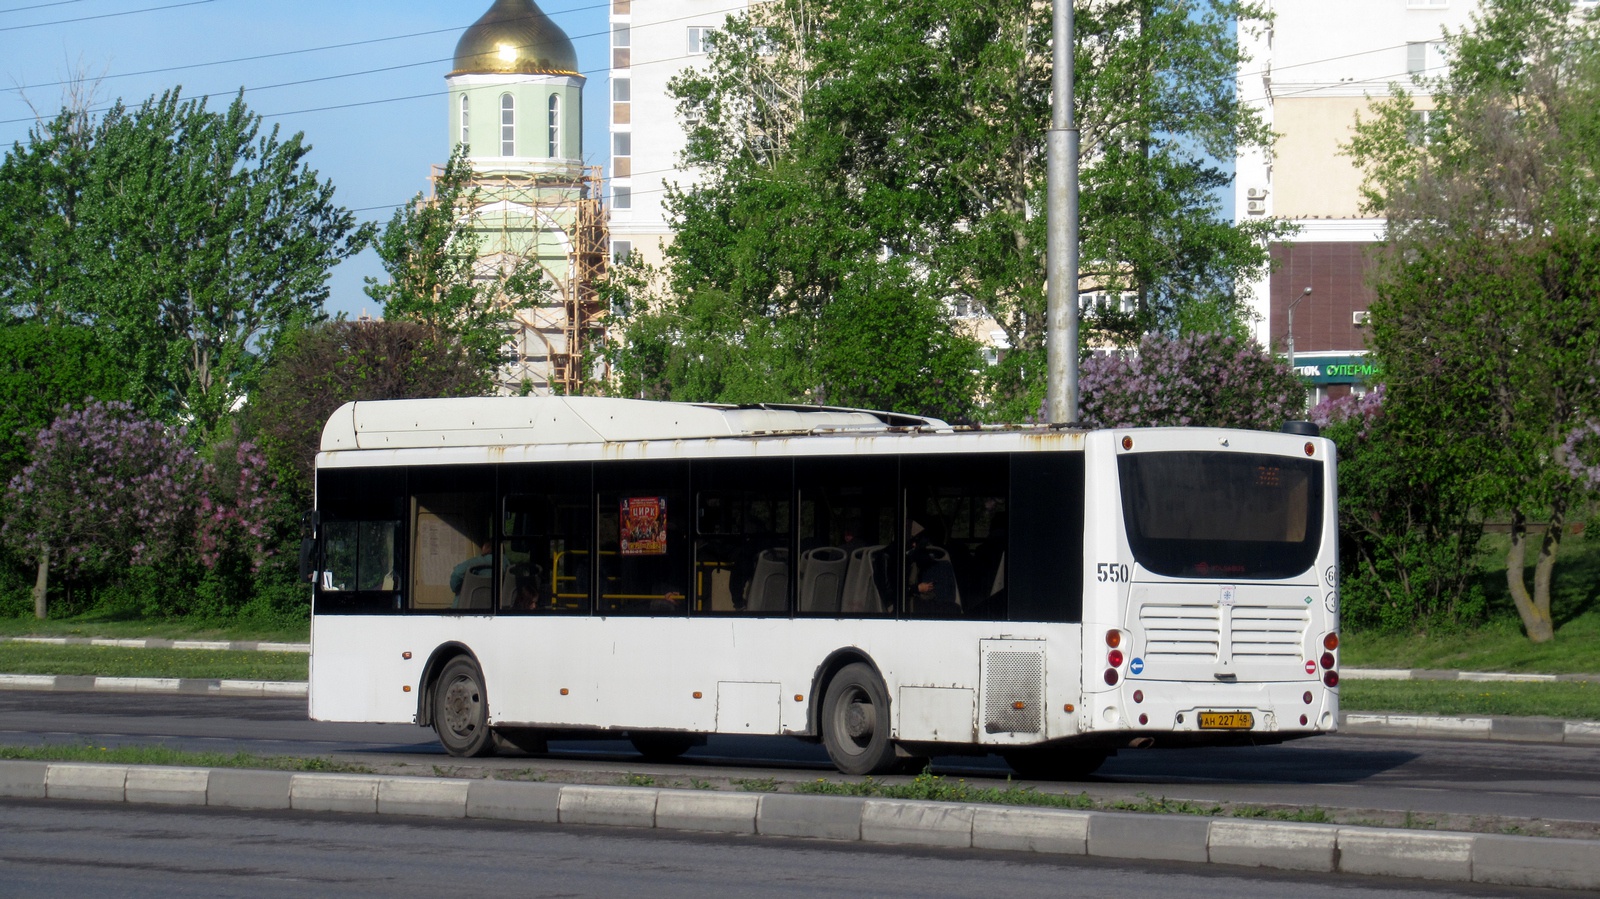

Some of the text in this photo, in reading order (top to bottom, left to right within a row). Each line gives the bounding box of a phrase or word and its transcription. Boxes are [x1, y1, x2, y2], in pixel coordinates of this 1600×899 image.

[633, 507, 655, 517] ЦИРК
[1097, 563, 1129, 583] 550
[1218, 715, 1235, 726] 227
